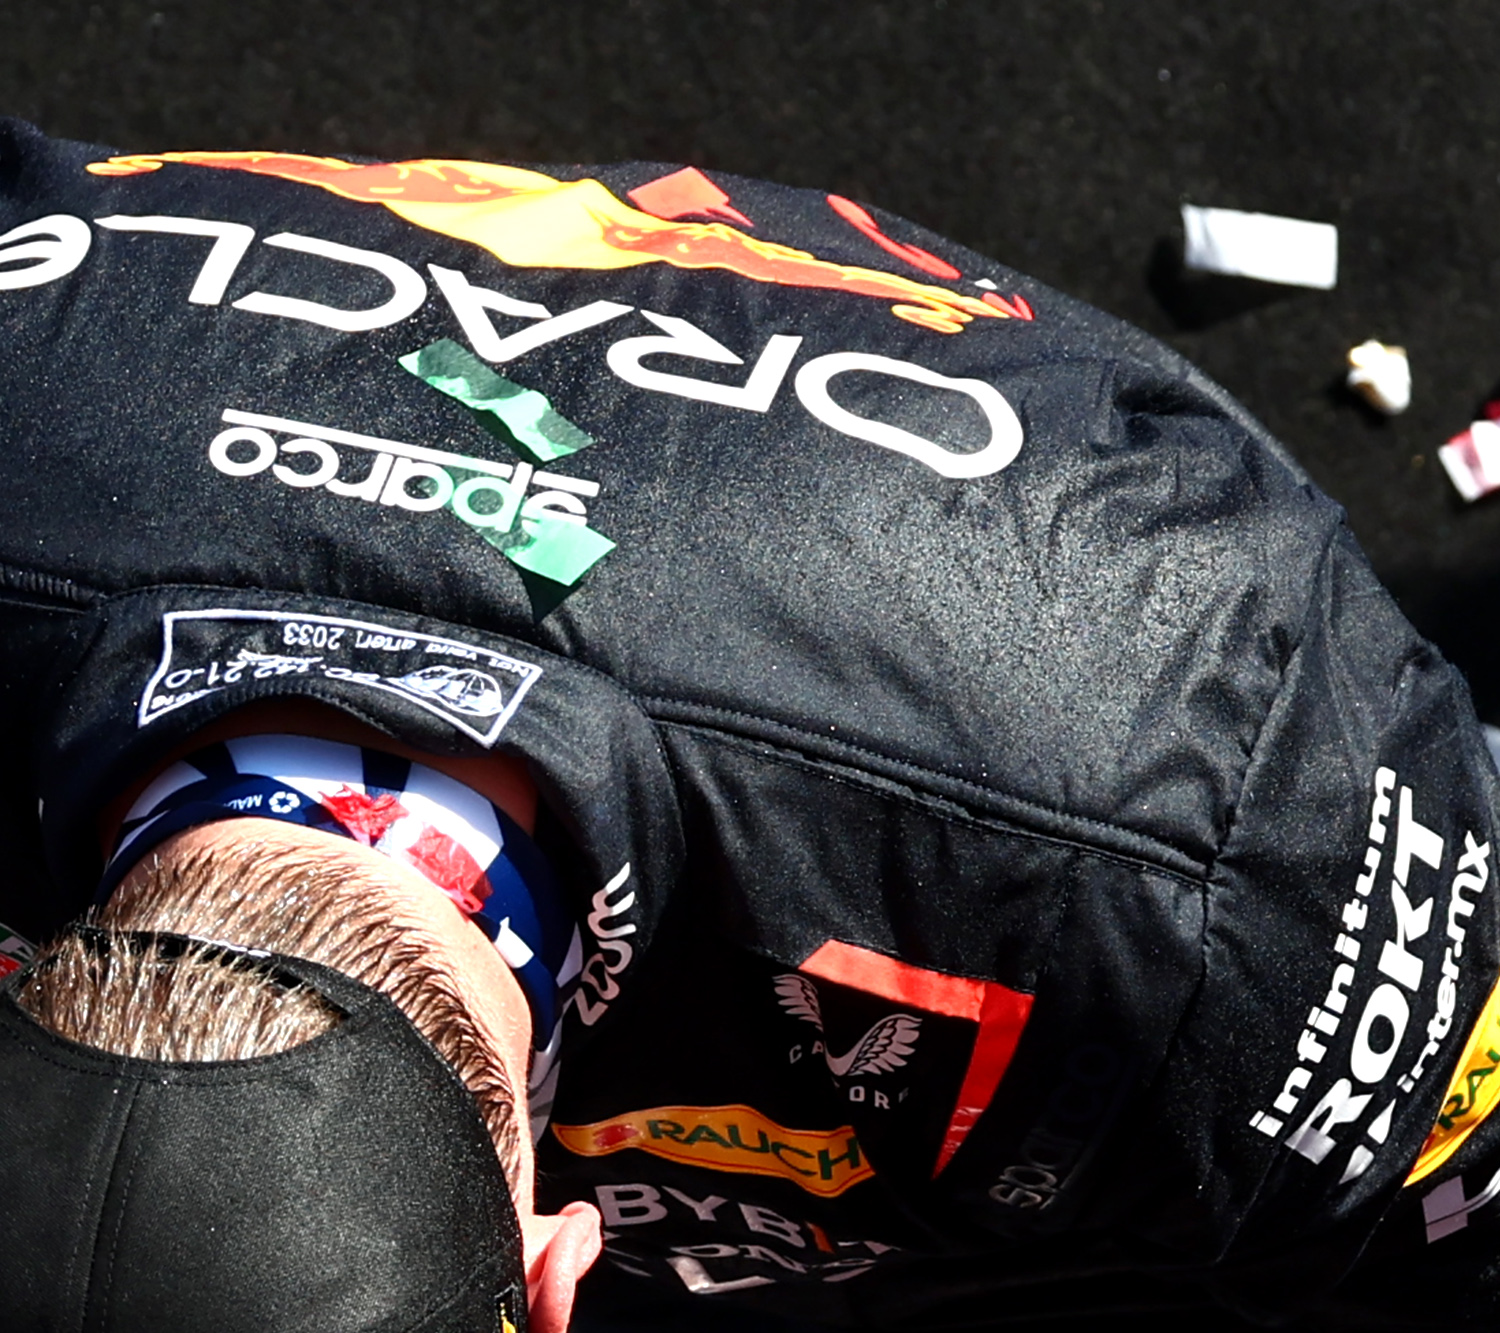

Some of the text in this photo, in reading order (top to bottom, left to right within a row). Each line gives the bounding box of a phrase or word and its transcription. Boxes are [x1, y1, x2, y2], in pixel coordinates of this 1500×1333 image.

[208, 426, 588, 533] sparco
[284, 621, 341, 651] 2033
[1248, 766, 1397, 1138] infinitum
[1285, 786, 1444, 1165] ROKT
[1397, 831, 1490, 1093] inter.mx
[645, 1118, 861, 1181] RAUCH
